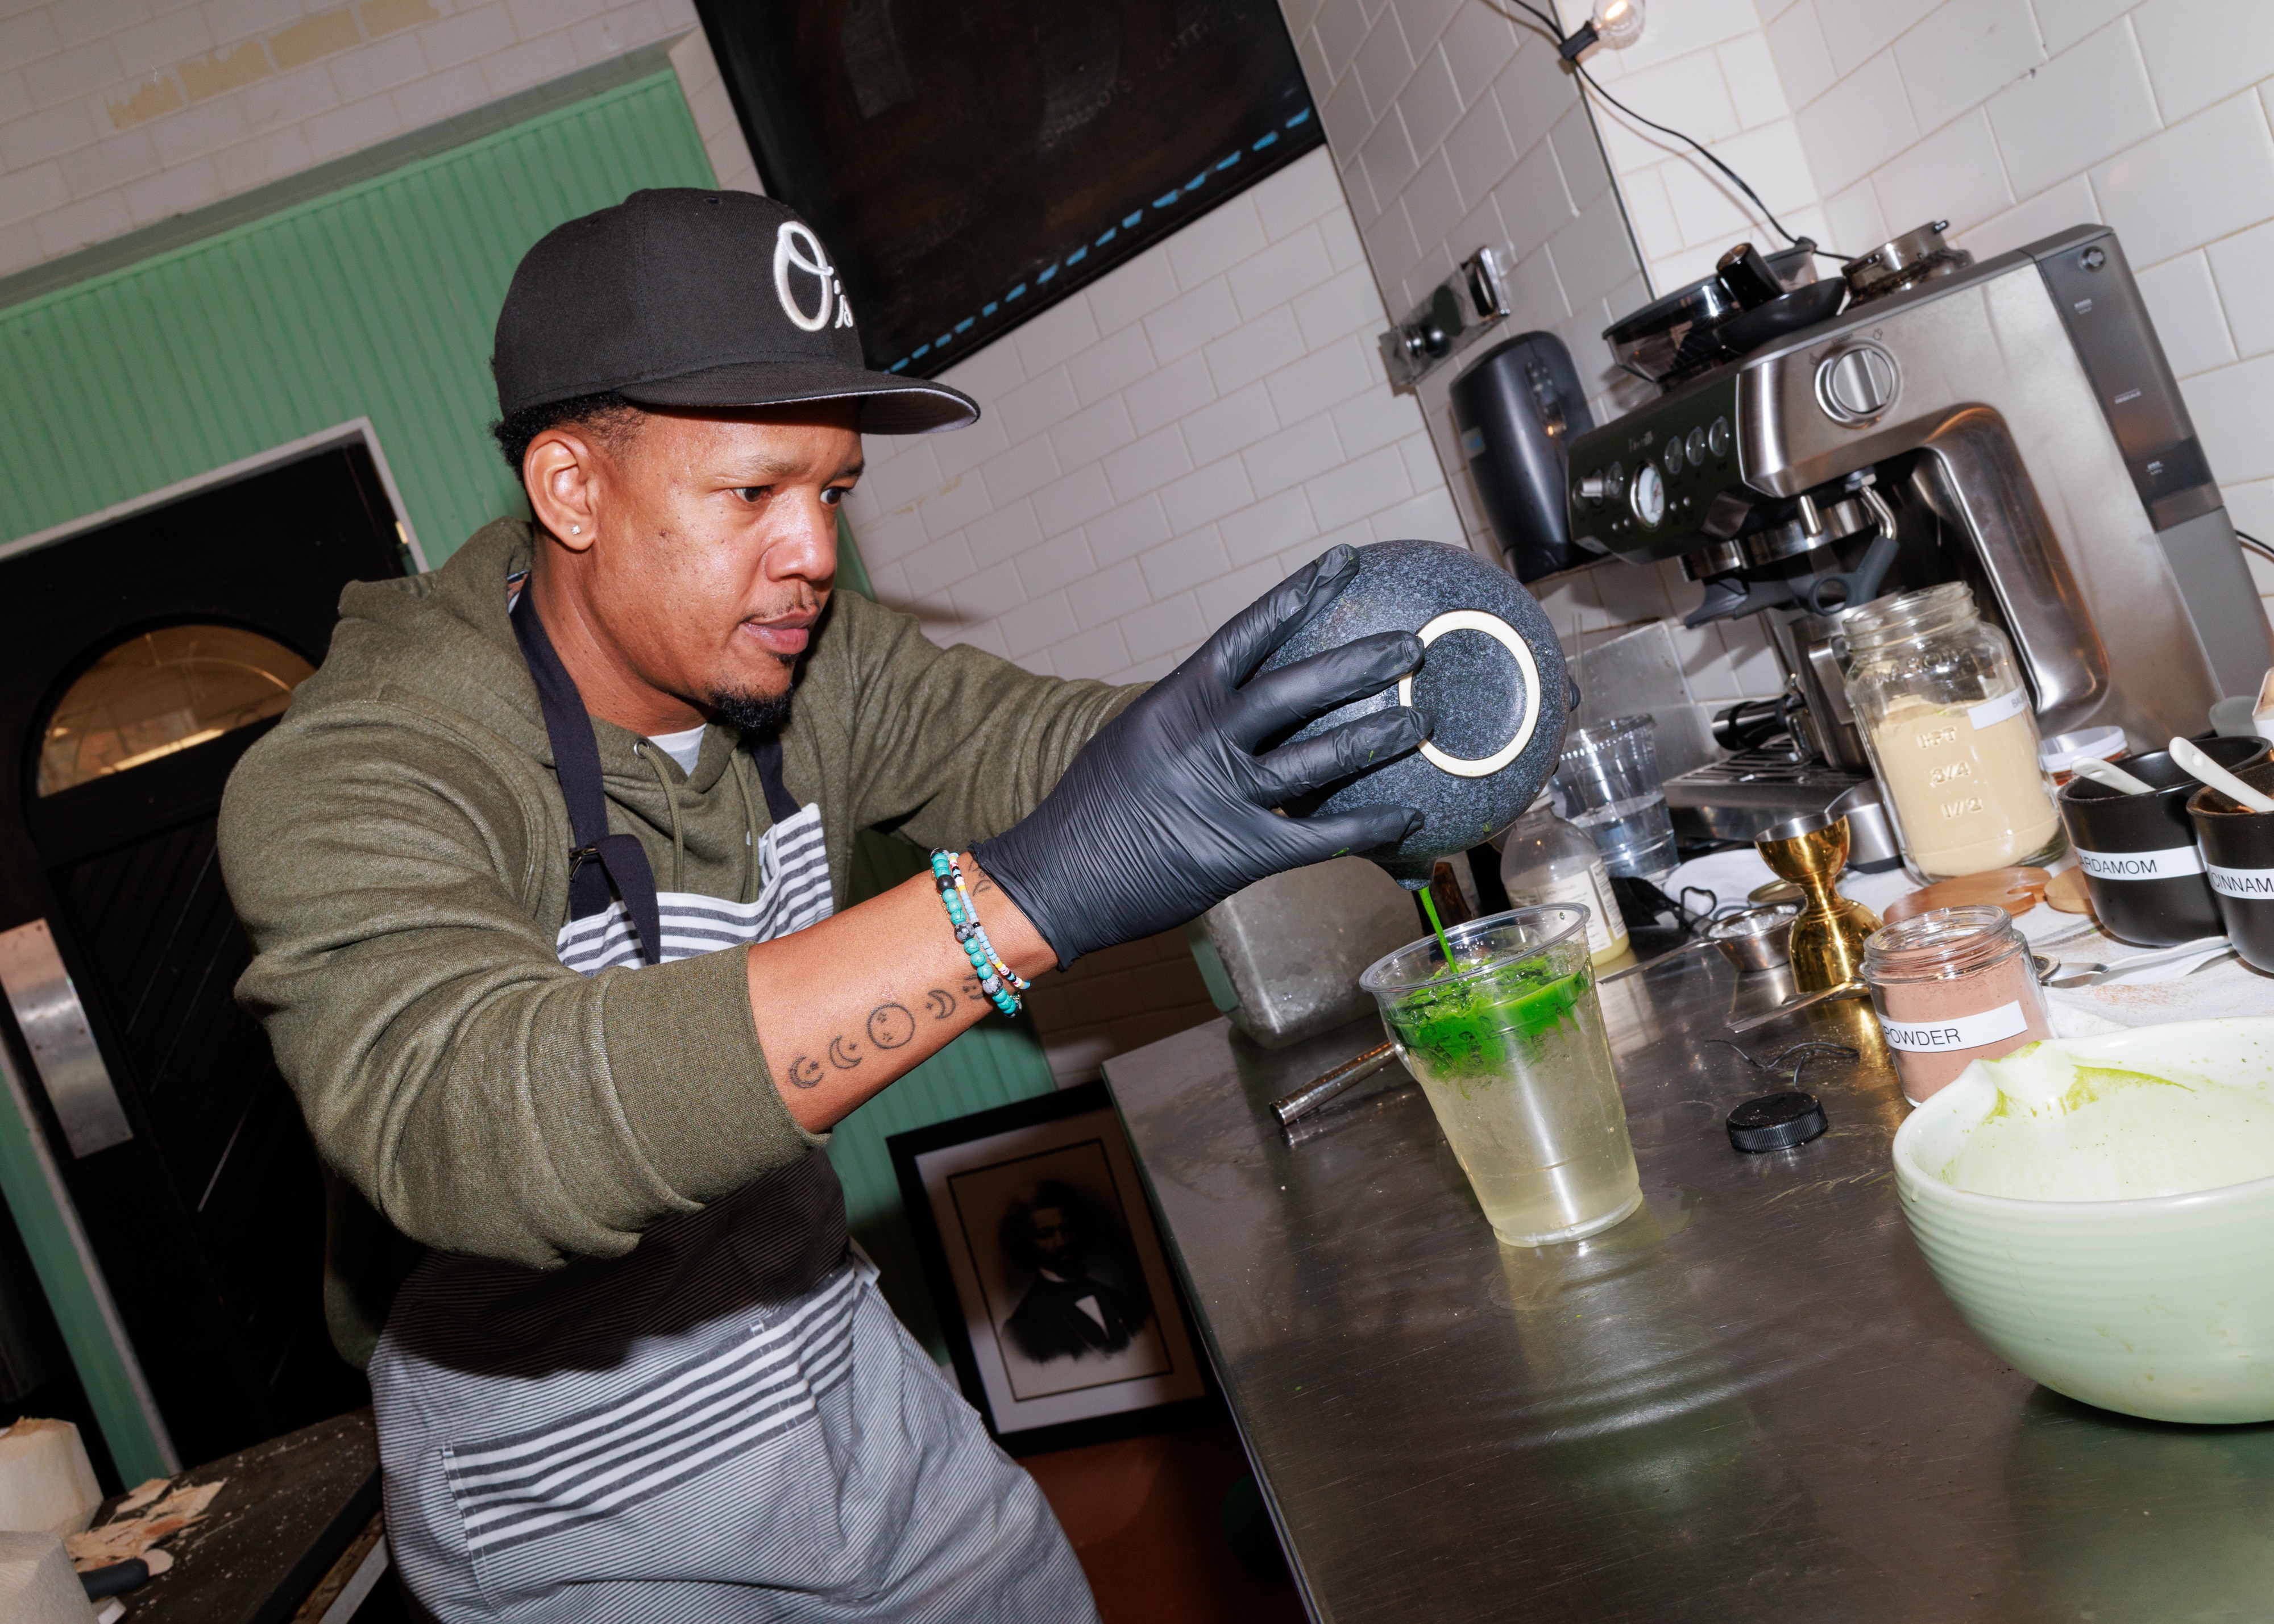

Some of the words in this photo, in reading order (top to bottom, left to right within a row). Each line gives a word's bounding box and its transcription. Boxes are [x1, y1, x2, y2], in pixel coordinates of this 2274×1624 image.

[2078, 855, 2157, 874] ARDAMOM
[2211, 872, 2274, 892] CINNAM
[1883, 1025, 1961, 1046] POWDER
